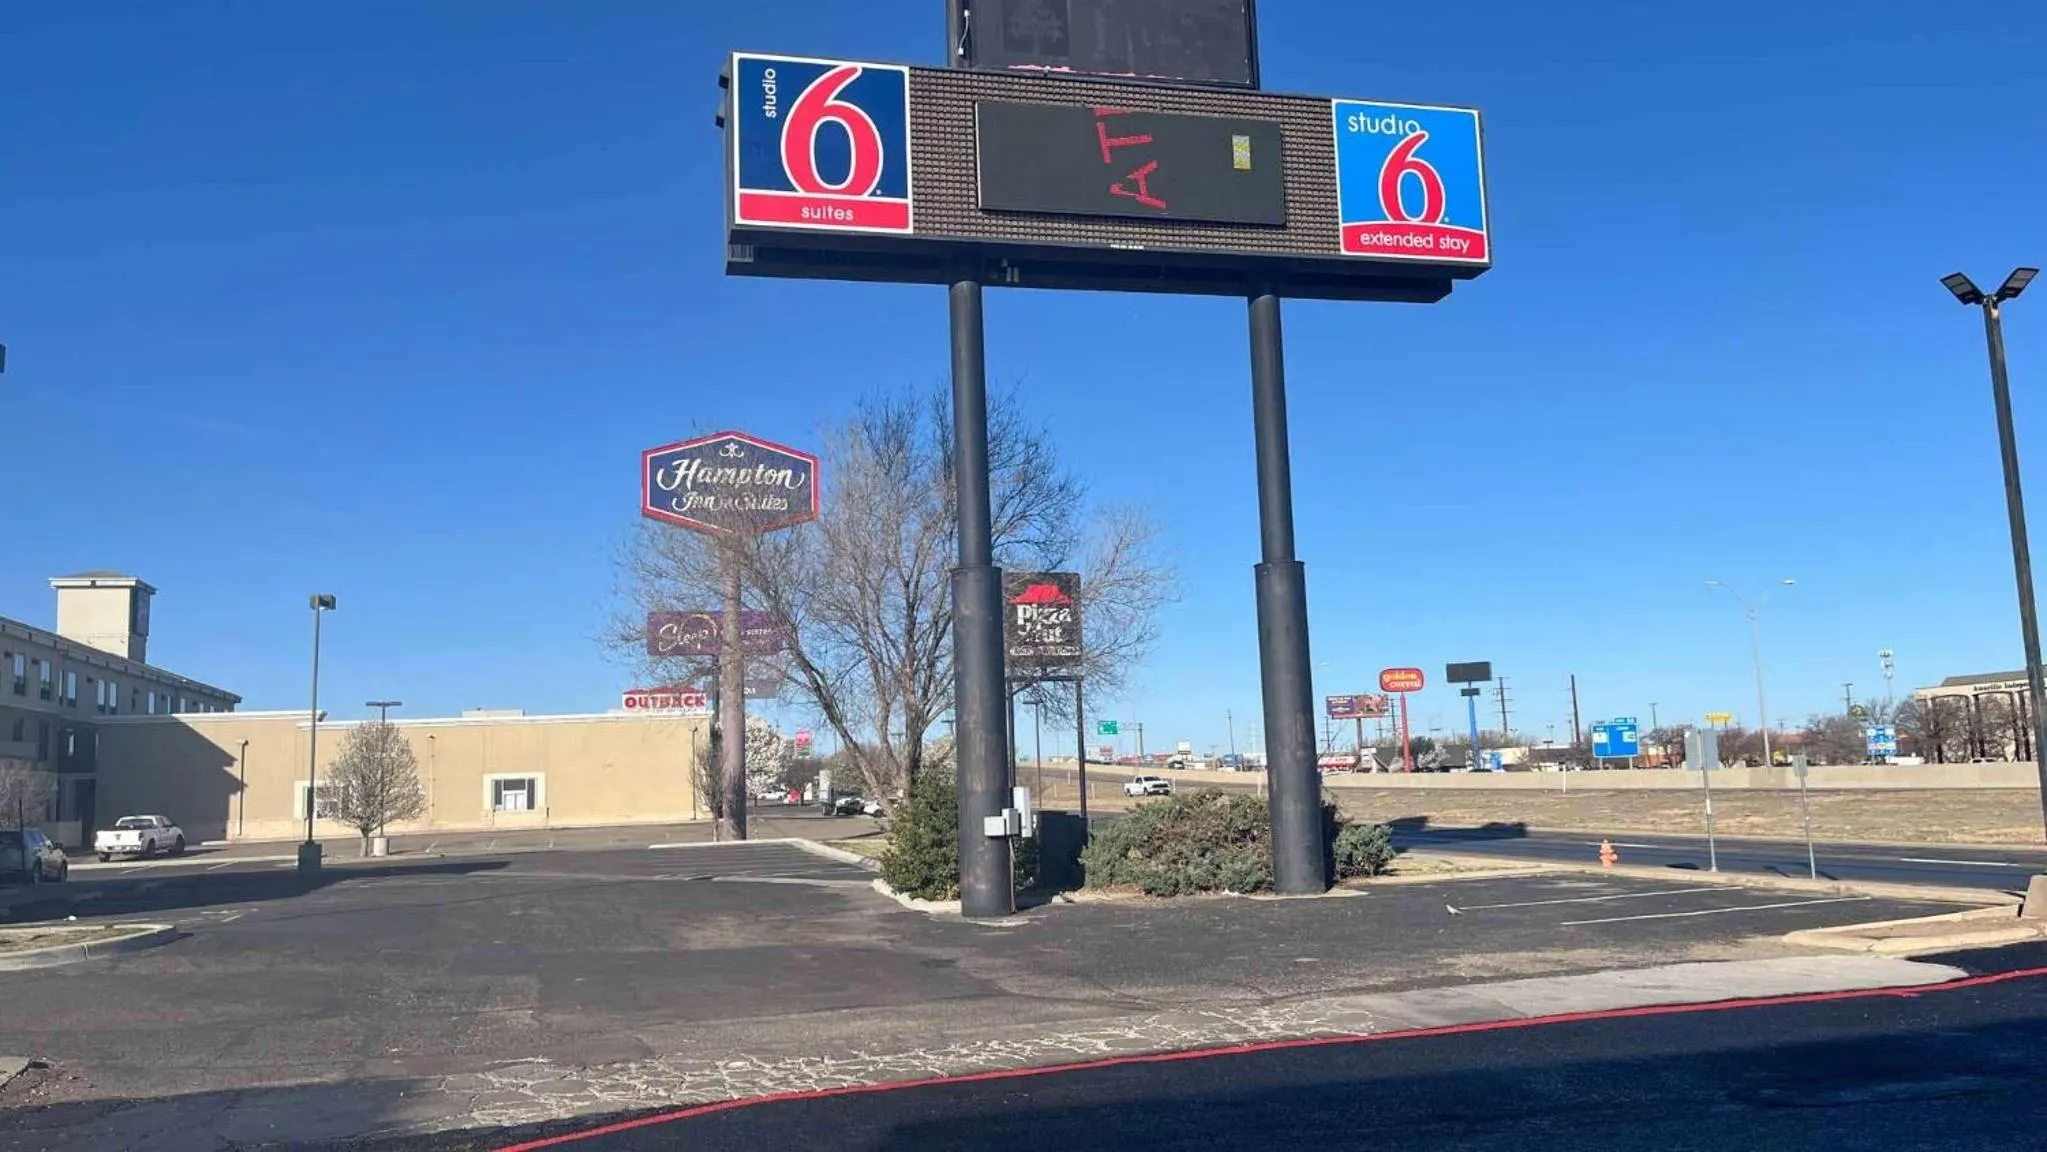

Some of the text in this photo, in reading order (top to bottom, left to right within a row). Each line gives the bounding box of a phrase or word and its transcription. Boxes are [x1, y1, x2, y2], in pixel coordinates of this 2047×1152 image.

[762, 67, 777, 118] studio
[781, 64, 883, 197] 6
[1347, 112, 1420, 136] studio
[1378, 130, 1446, 225] 6
[800, 204, 854, 221] suites
[1360, 232, 1470, 254] extended stay
[656, 458, 806, 491] Hampton
[1017, 603, 1072, 625] Pizza
[624, 695, 706, 709] OUTBACK
